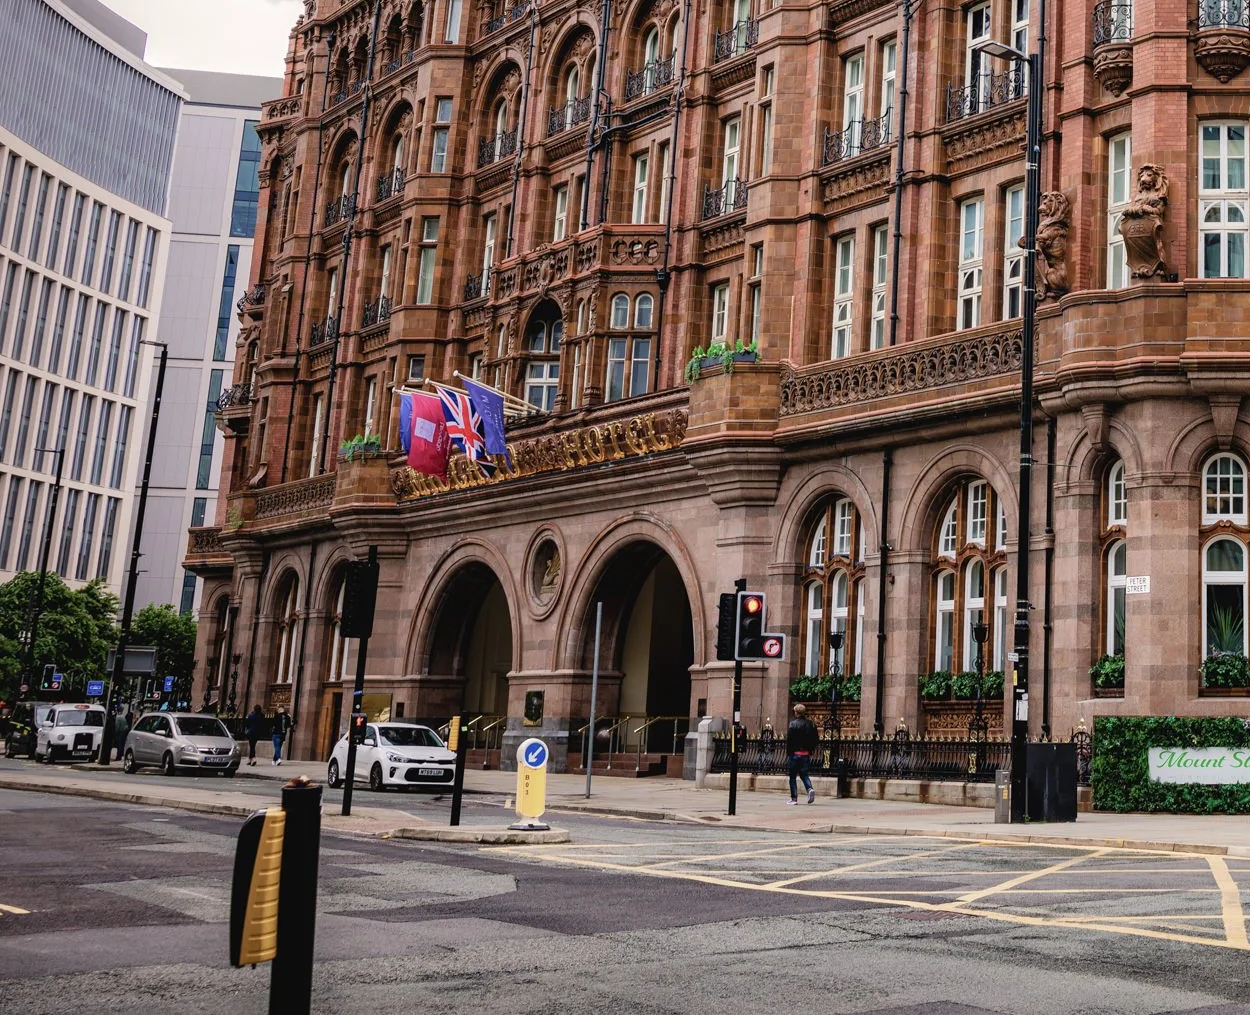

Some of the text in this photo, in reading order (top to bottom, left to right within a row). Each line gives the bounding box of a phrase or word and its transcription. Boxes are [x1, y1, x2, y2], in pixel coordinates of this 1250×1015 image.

[561, 412, 672, 469] HOTEL
[1129, 577, 1147, 585] PETER
[1126, 584, 1147, 593] STREET
[1156, 750, 1227, 769] Mount
